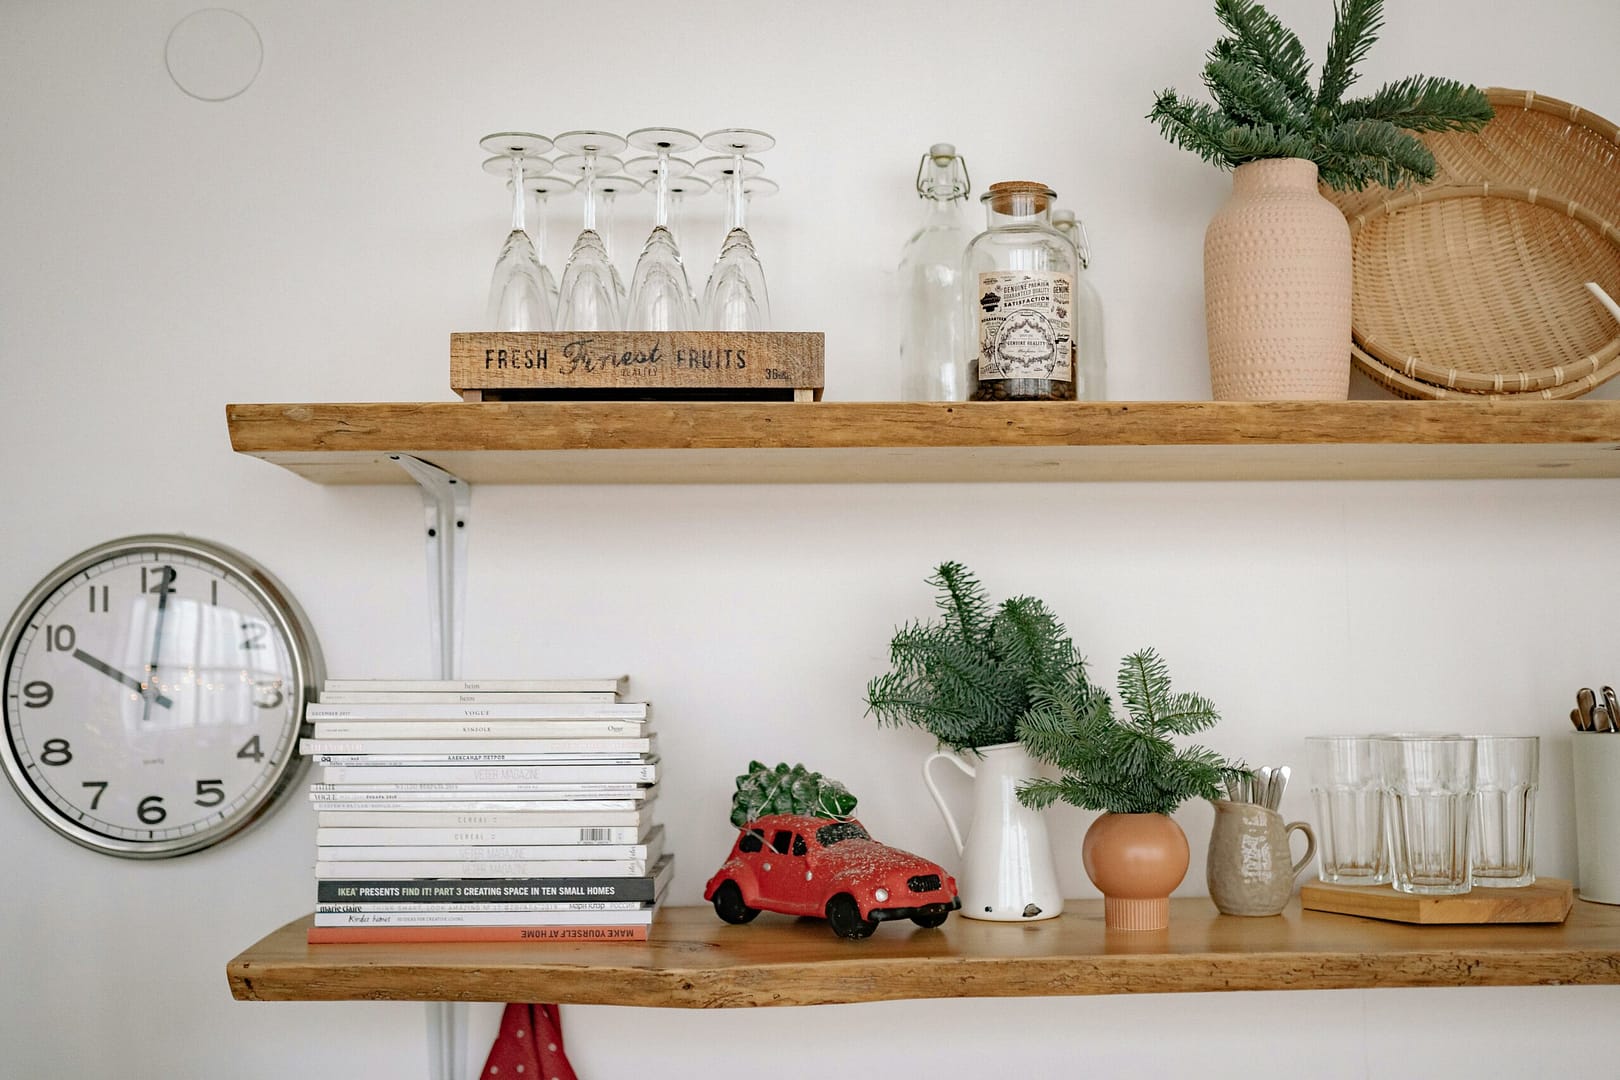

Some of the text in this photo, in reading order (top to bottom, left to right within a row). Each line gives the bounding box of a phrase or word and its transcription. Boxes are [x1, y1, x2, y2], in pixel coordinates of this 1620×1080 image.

[1003, 295, 1050, 308] SATISFACTION
[485, 338, 747, 376] FRESH Finest FRUITS
[141, 566, 177, 594] 12
[211, 579, 218, 606] 1
[89, 585, 109, 612] 11
[46, 624, 76, 652] 10
[239, 622, 266, 649] 2
[23, 681, 54, 708] 9
[252, 681, 284, 709] 3
[40, 738, 73, 766] 8
[236, 735, 265, 763] 4
[501, 768, 540, 780] MAGAZINE
[82, 781, 109, 810] 7
[194, 779, 225, 807] 5
[137, 795, 167, 824] 6
[457, 816, 488, 824] CEREAL
[454, 833, 484, 841] CEREAL
[359, 887, 400, 896] PRESENTS
[402, 887, 420, 896] FIND
[422, 887, 432, 896] IT!
[433, 887, 454, 896] PART
[456, 887, 462, 896] 3
[463, 887, 502, 896] CREATING
[503, 887, 529, 896] SPACE
[531, 887, 540, 896] IN
[541, 887, 557, 896] TEN
[558, 887, 585, 896] SMALL
[587, 887, 615, 896] HOMES
[319, 904, 362, 913] marie claire
[520, 929, 634, 938] MAKE YOURSELF AT HOME
